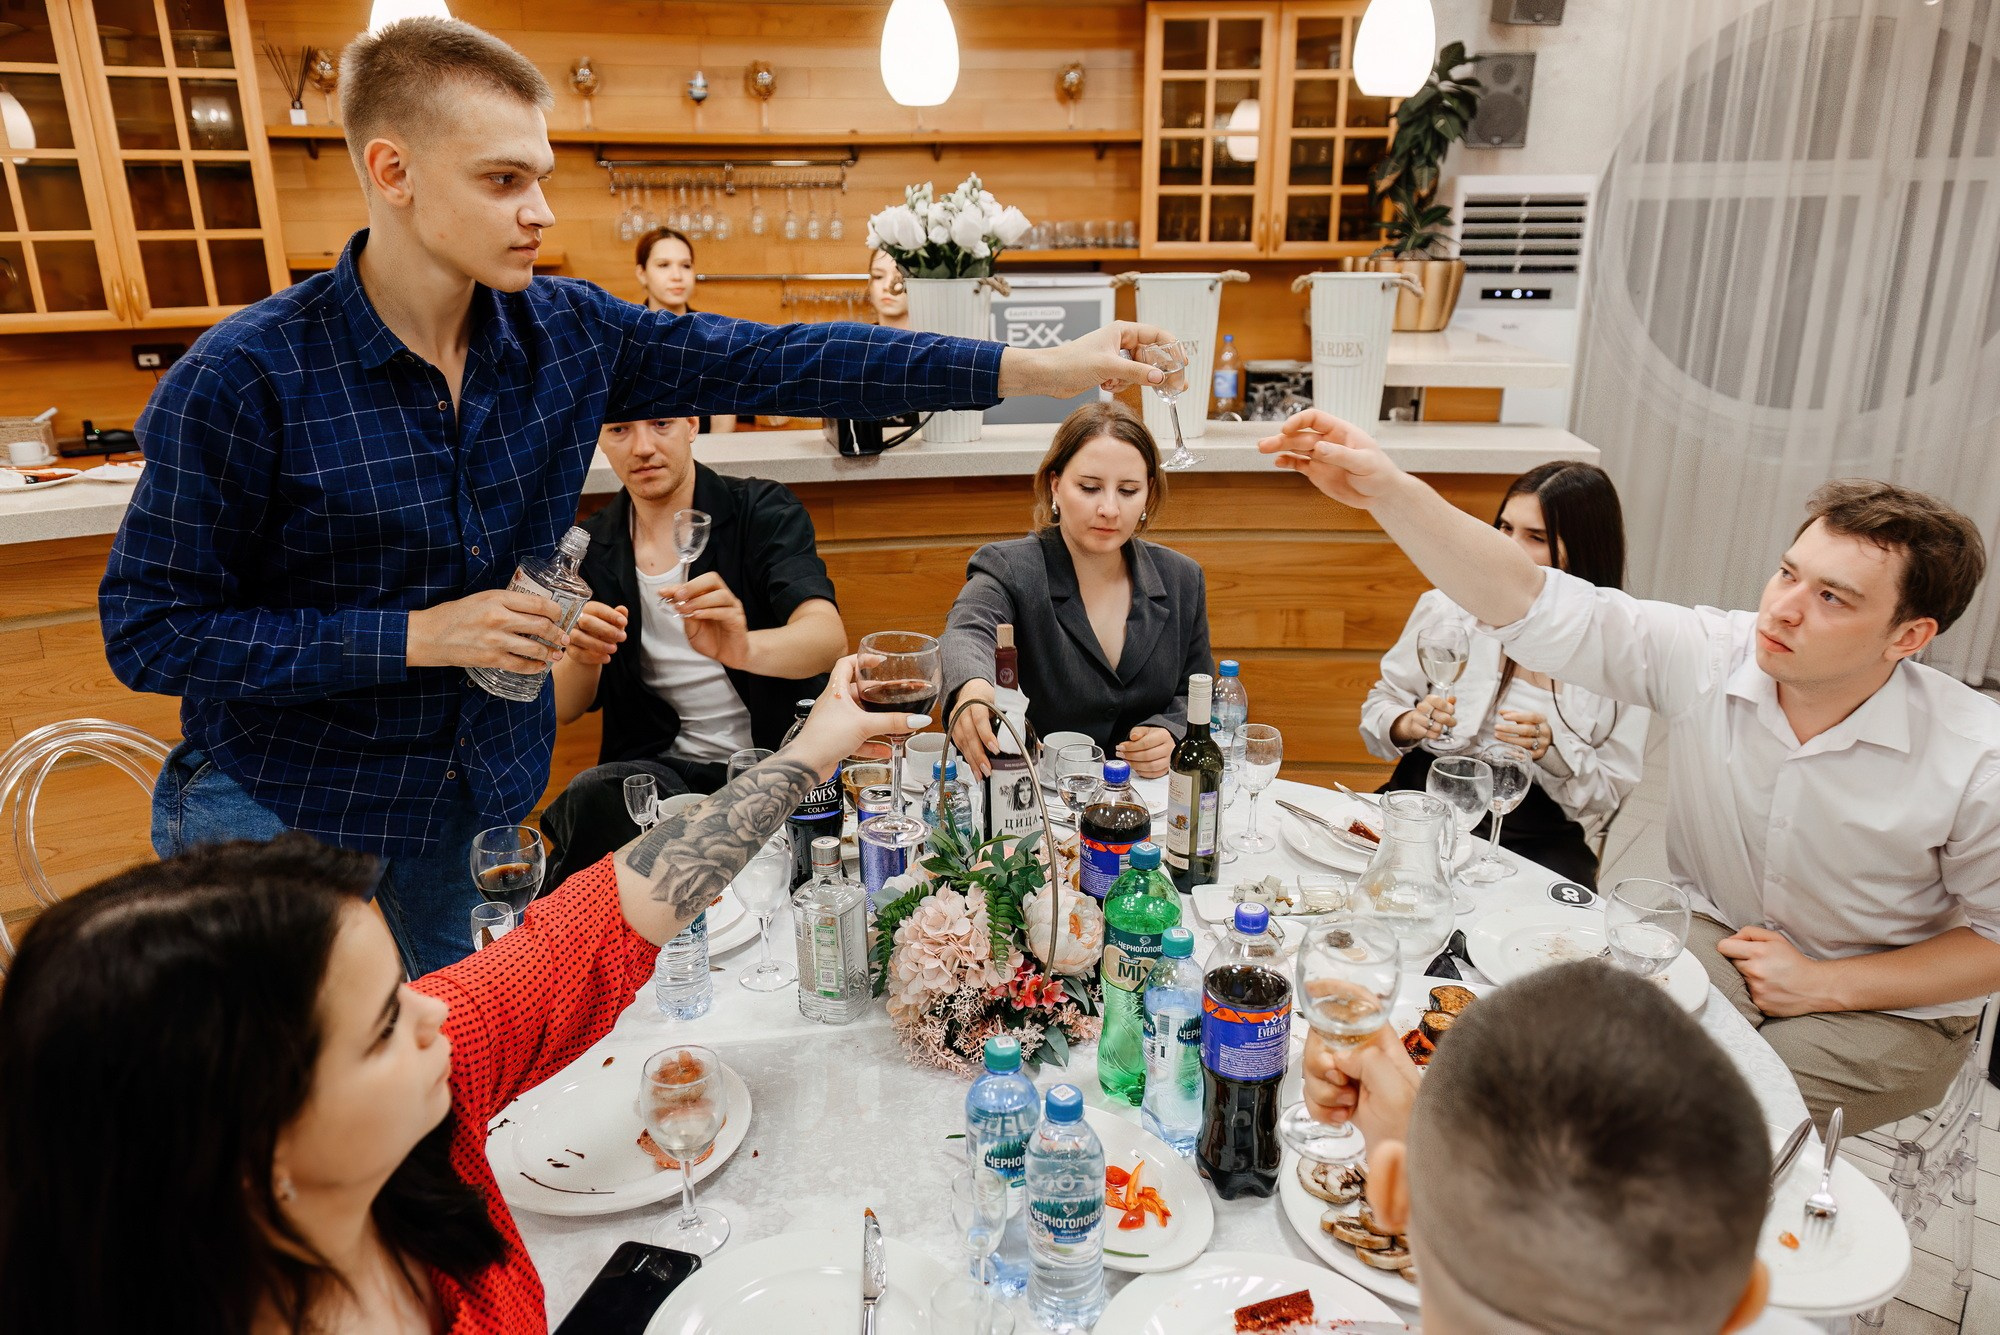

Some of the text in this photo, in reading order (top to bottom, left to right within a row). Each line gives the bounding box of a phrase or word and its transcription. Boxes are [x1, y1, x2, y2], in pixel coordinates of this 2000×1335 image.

[1561, 887, 1580, 902] 20
[1118, 940, 1162, 954] ЧЕРНОГОЛОВ
[1031, 1204, 1104, 1230] ЧЕРНОГОЛОВКА
